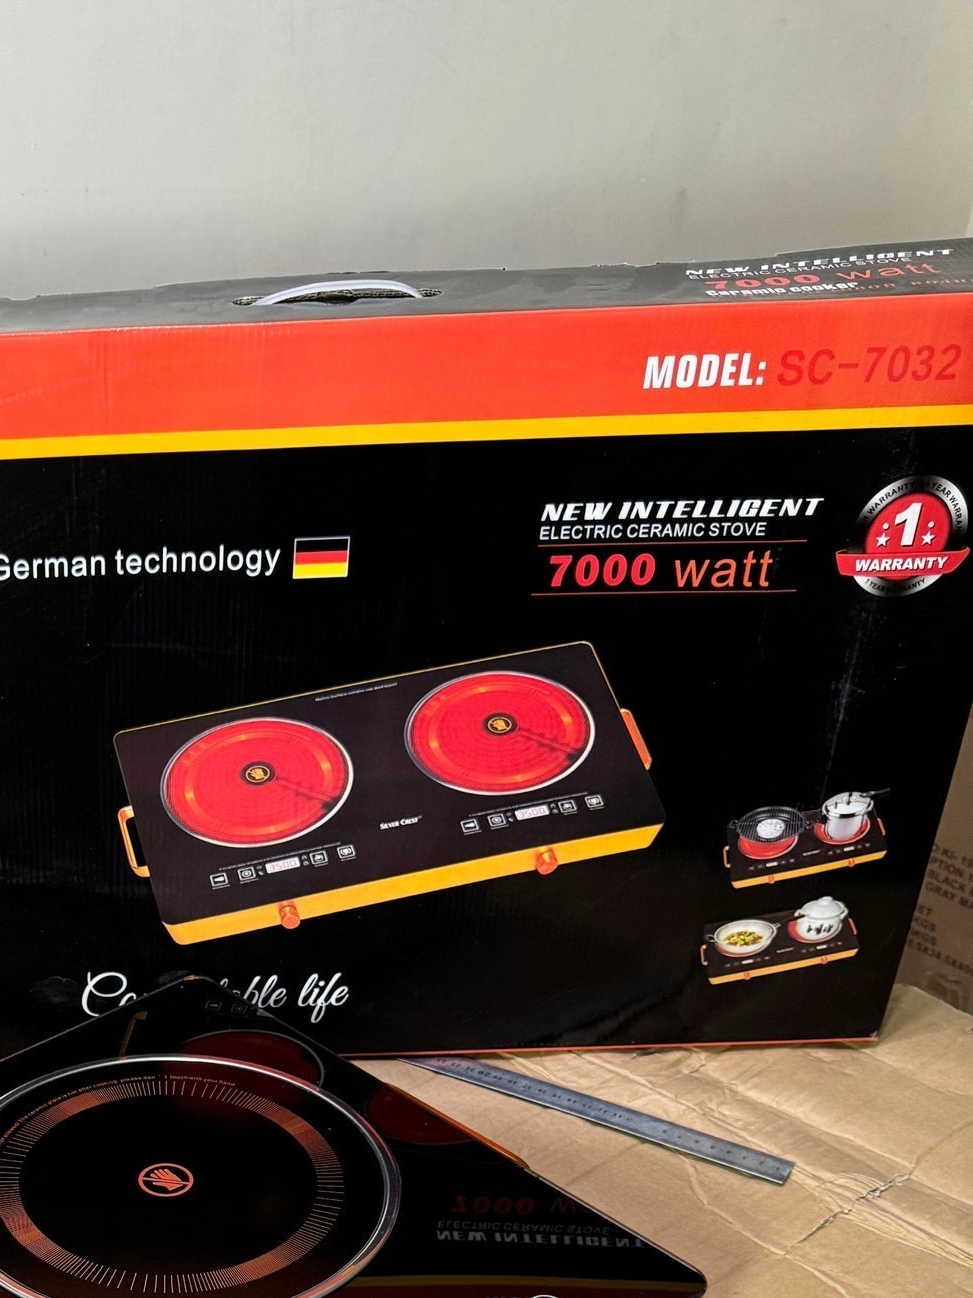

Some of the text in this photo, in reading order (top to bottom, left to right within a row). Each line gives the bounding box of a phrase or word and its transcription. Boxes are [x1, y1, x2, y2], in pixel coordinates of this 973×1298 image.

[685, 249, 954, 276] NEW INTELLIGENT
[688, 256, 912, 281] ELECTRIC CERAMIC STOVE
[705, 274, 820, 290] 7000
[837, 263, 940, 281] watt
[789, 281, 859, 294] cooker
[642, 345, 963, 390] MODEL: SC-7032
[540, 498, 825, 522] NEW INTELLIGENT
[538, 521, 768, 541] ELECTRIC CERAMIC STOVE
[893, 502, 924, 547] 1
[114, 543, 281, 576] technology
[549, 549, 774, 589] 7000 watt
[855, 556, 949, 573] WARRANTY
[296, 972, 350, 1023] life
